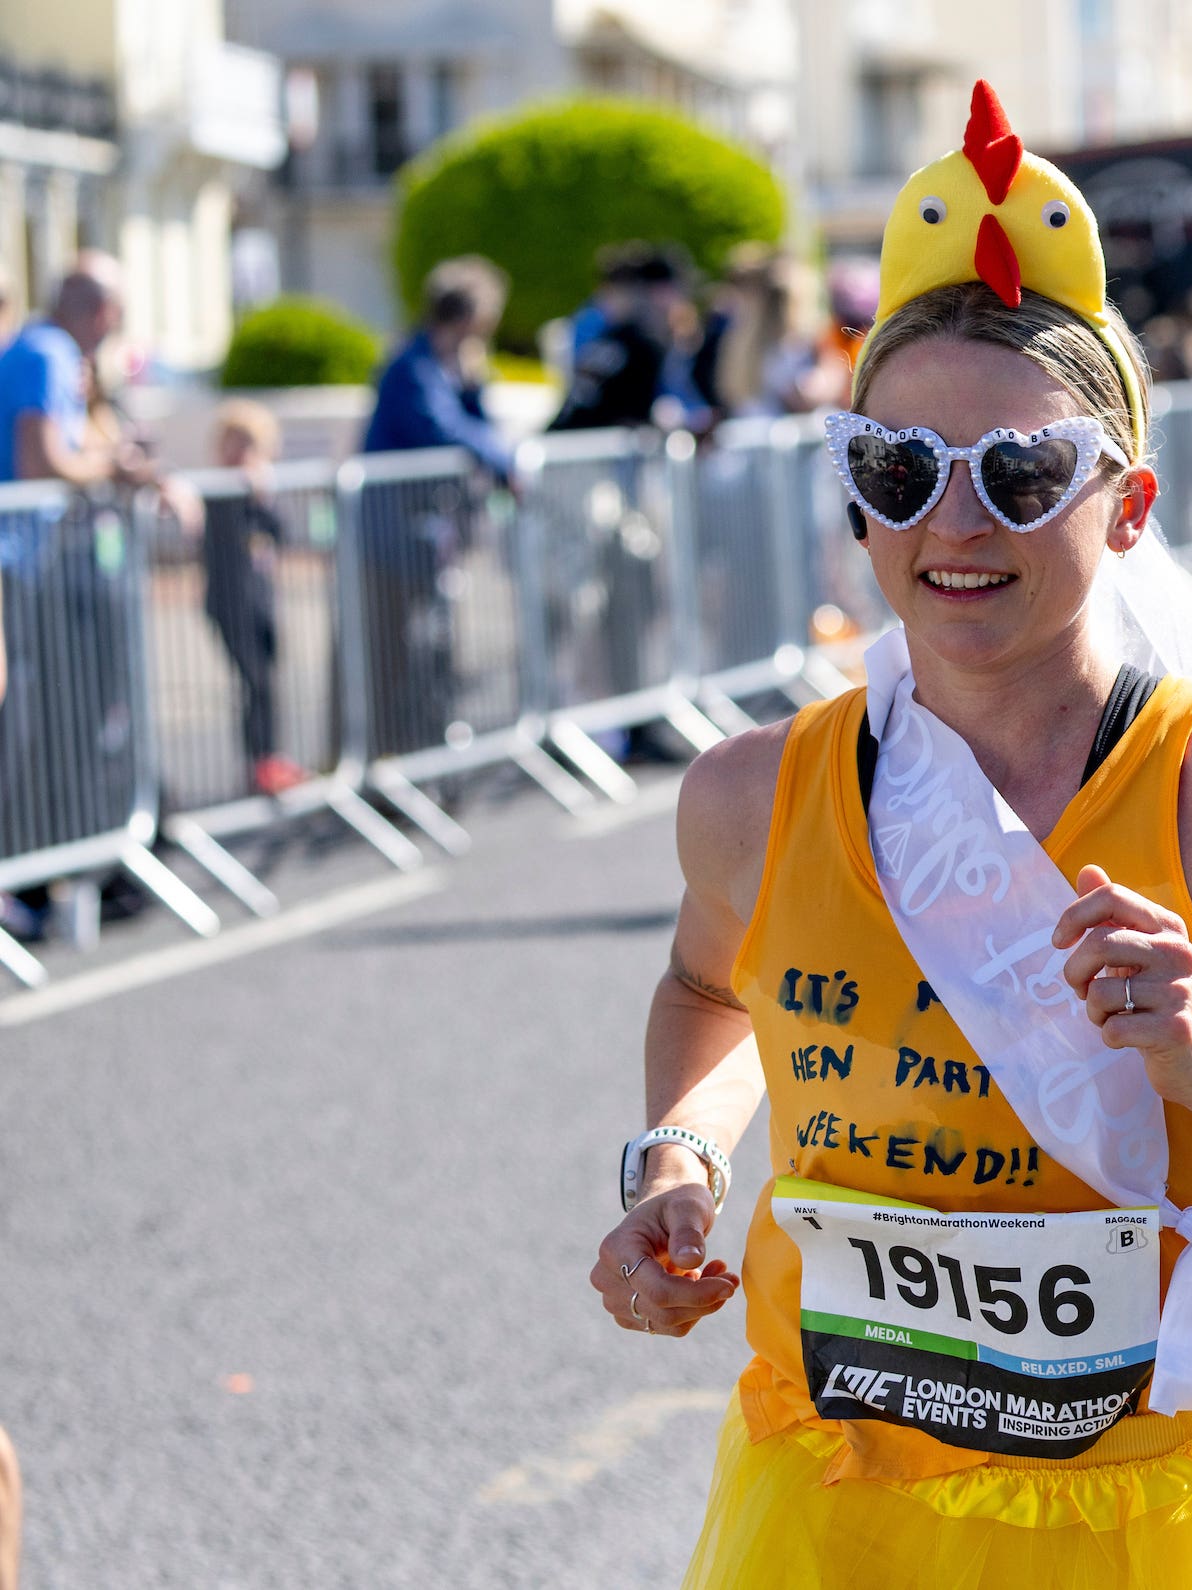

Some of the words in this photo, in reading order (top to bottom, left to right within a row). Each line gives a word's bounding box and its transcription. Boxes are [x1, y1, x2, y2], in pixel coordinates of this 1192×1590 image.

[865, 423, 918, 442] BRIDE
[995, 430, 1014, 439] TO
[1031, 428, 1050, 443] BE
[784, 968, 859, 1012] IT'S
[791, 1045, 854, 1082] HEN
[797, 1110, 1040, 1186] WEEKEND!!
[793, 1206, 818, 1214] WAVE
[872, 1211, 1046, 1229] #BrightonMarathonWeekend
[1104, 1216, 1148, 1225] BAGGAGE
[1120, 1229, 1135, 1248] B
[847, 1237, 1096, 1337] 19156
[864, 1324, 913, 1345] MEDAL
[1021, 1360, 1092, 1375] RELAXED,
[1094, 1355, 1126, 1369] SML
[905, 1376, 1001, 1412] LONDON
[902, 1397, 987, 1430] EVENTS
[1003, 1417, 1071, 1437] INSPIRING
